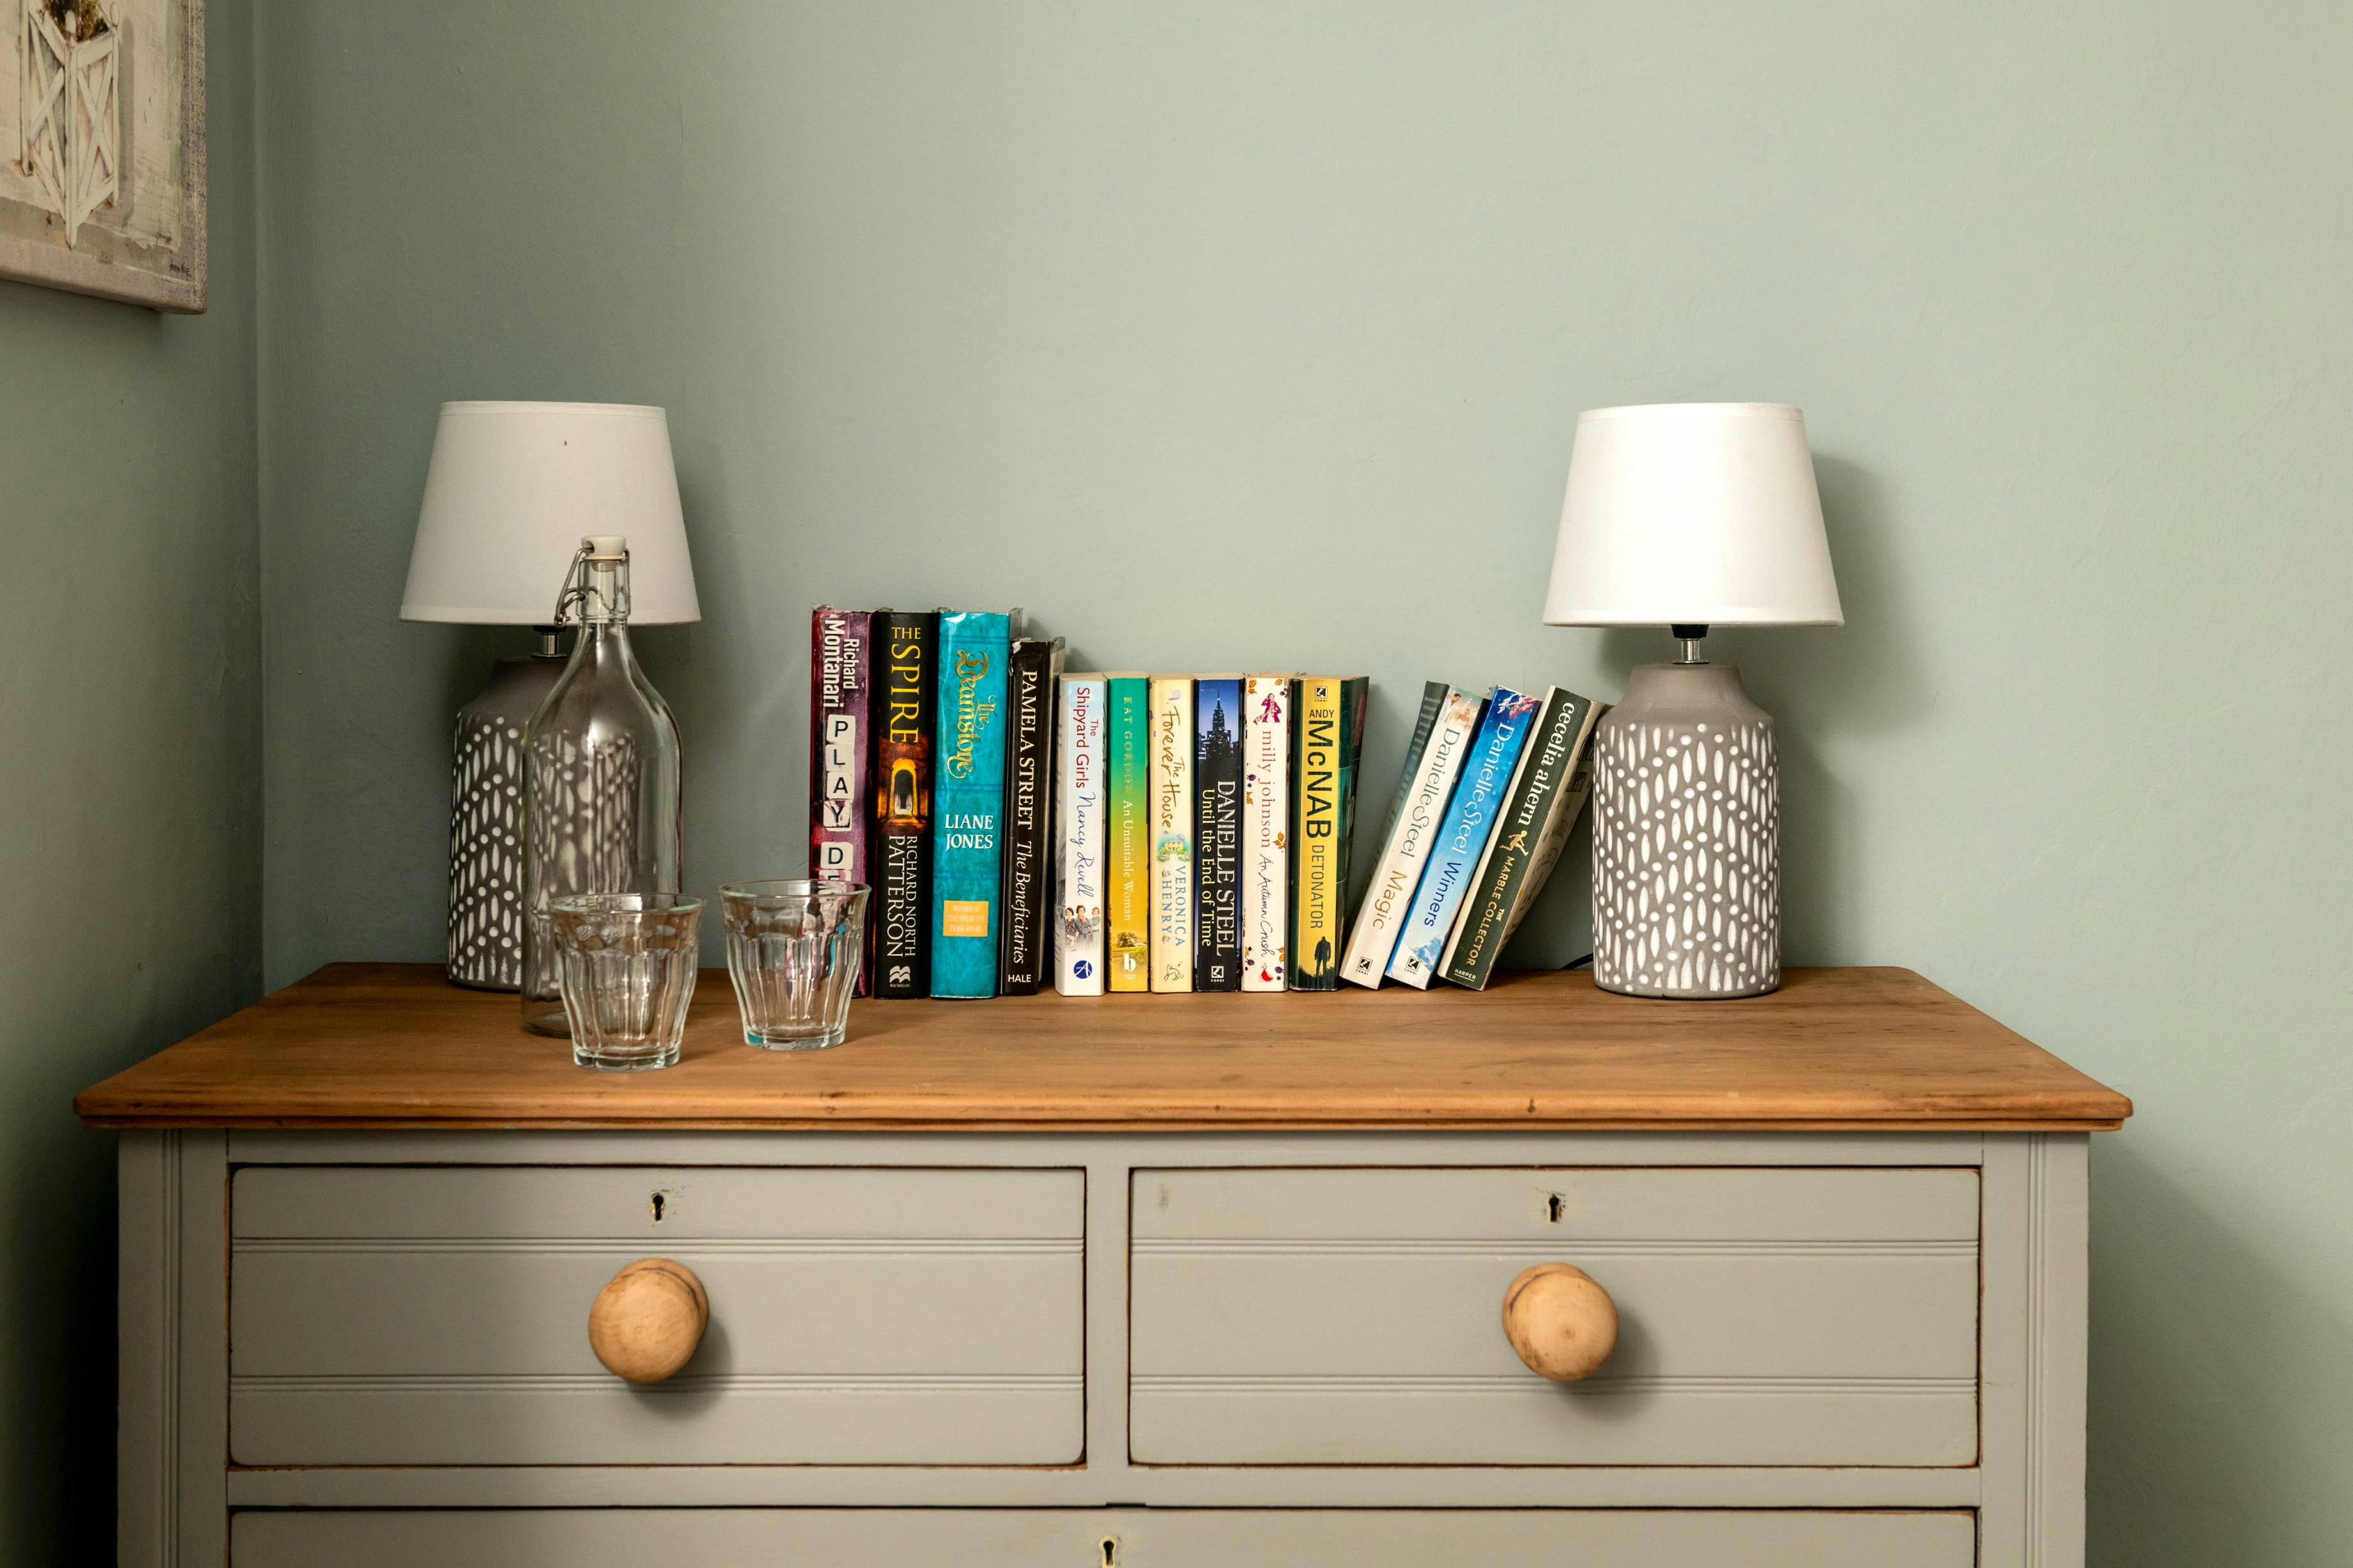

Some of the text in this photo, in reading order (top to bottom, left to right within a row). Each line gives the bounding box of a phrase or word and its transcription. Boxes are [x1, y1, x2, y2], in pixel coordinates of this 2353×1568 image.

[823, 620, 846, 707] Montanari
[843, 638, 859, 690] Richard
[892, 627, 921, 639] THE
[890, 643, 920, 743] SPIRE
[947, 649, 989, 779] Dreamstone
[973, 695, 998, 731] The
[1090, 719, 1099, 736] The
[1308, 709, 1335, 718] ANDY
[831, 720, 849, 823] PLAY
[1073, 687, 1090, 788] Shipyard Girls
[1162, 706, 1181, 828] Forever House
[1173, 757, 1185, 777] The
[1419, 727, 1461, 807] Danielle
[1517, 702, 1575, 827] cecelia ahern
[945, 814, 994, 830] LIANE
[945, 834, 993, 852] JONES
[1011, 670, 1038, 964] PAMELA STREET The Beneficiaries
[1070, 791, 1096, 898] Nancy Revell
[1123, 697, 1134, 921] KAT GORDON An Unsuitable Woman
[1257, 731, 1276, 958] milly johnson An Autumn Crush
[1401, 805, 1431, 858] Steel
[1424, 722, 1515, 928] Danielle Steel Winners
[886, 835, 905, 957] PATTERSON
[904, 836, 917, 957] RICHARD NORTH
[1162, 880, 1173, 934] HENRY
[1175, 866, 1185, 946] VERONICA
[1201, 789, 1216, 947] Until the End of Time
[1216, 780, 1235, 957] DANIELLE STEEL
[1310, 845, 1324, 929] DETONATOR
[1373, 870, 1408, 930] Magic
[1466, 856, 1515, 966] MARBLE COLLECTOR
[1495, 908, 1505, 922] THE
[1007, 974, 1032, 983] HALE
[1454, 967, 1477, 980] HARPER
